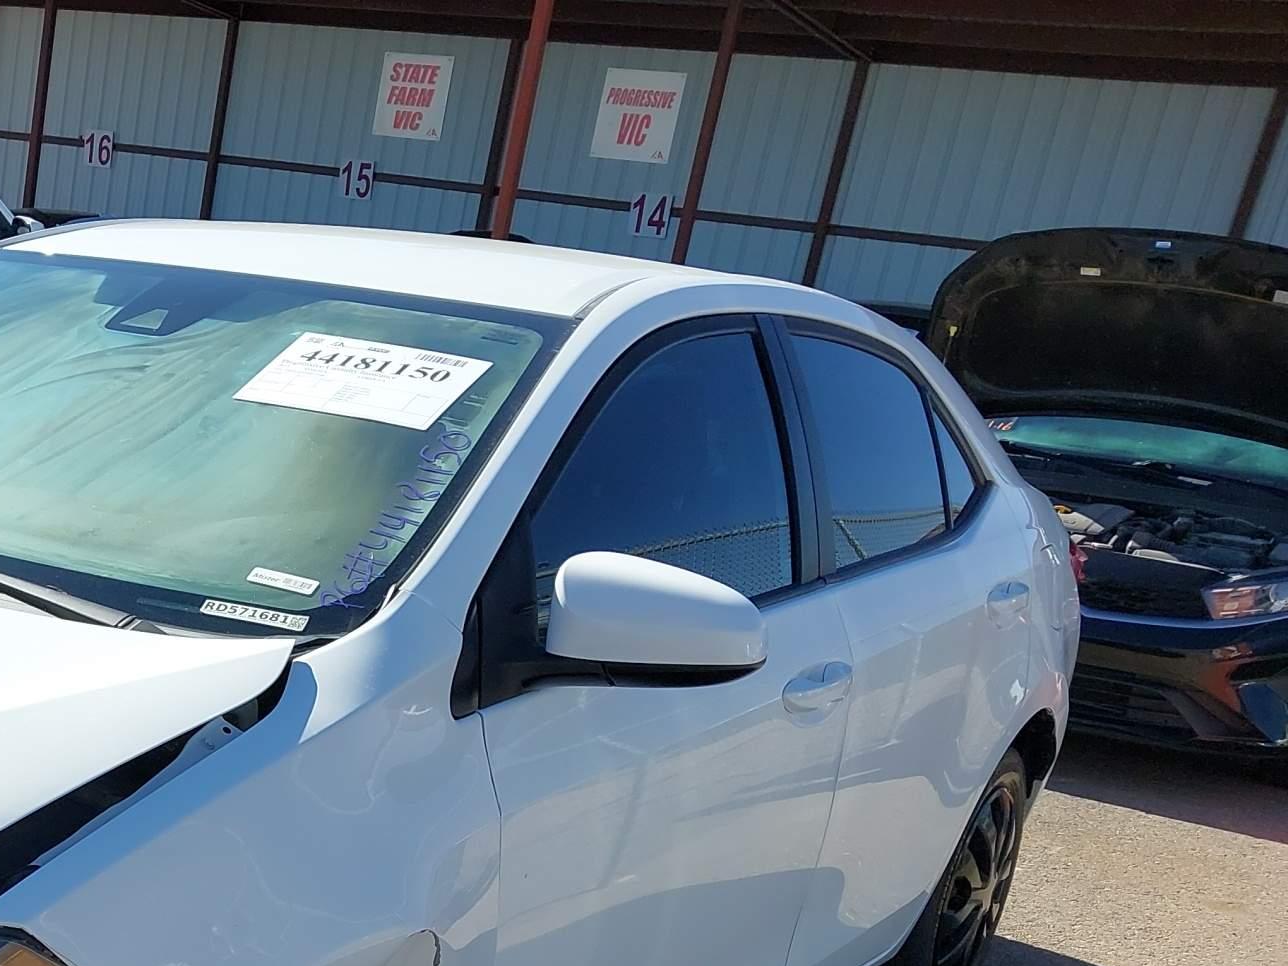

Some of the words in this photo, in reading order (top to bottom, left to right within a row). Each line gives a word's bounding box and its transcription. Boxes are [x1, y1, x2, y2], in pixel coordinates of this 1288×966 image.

[390, 62, 441, 84] STATE
[386, 85, 435, 108] FARM
[605, 87, 677, 110] PROGRESSIVE
[392, 110, 424, 131] VIC
[616, 112, 652, 147] VIC
[85, 133, 112, 166] 16
[342, 160, 373, 198] 15
[632, 193, 668, 236] 14
[300, 350, 451, 383] 44181150
[203, 601, 289, 624] RD571681
